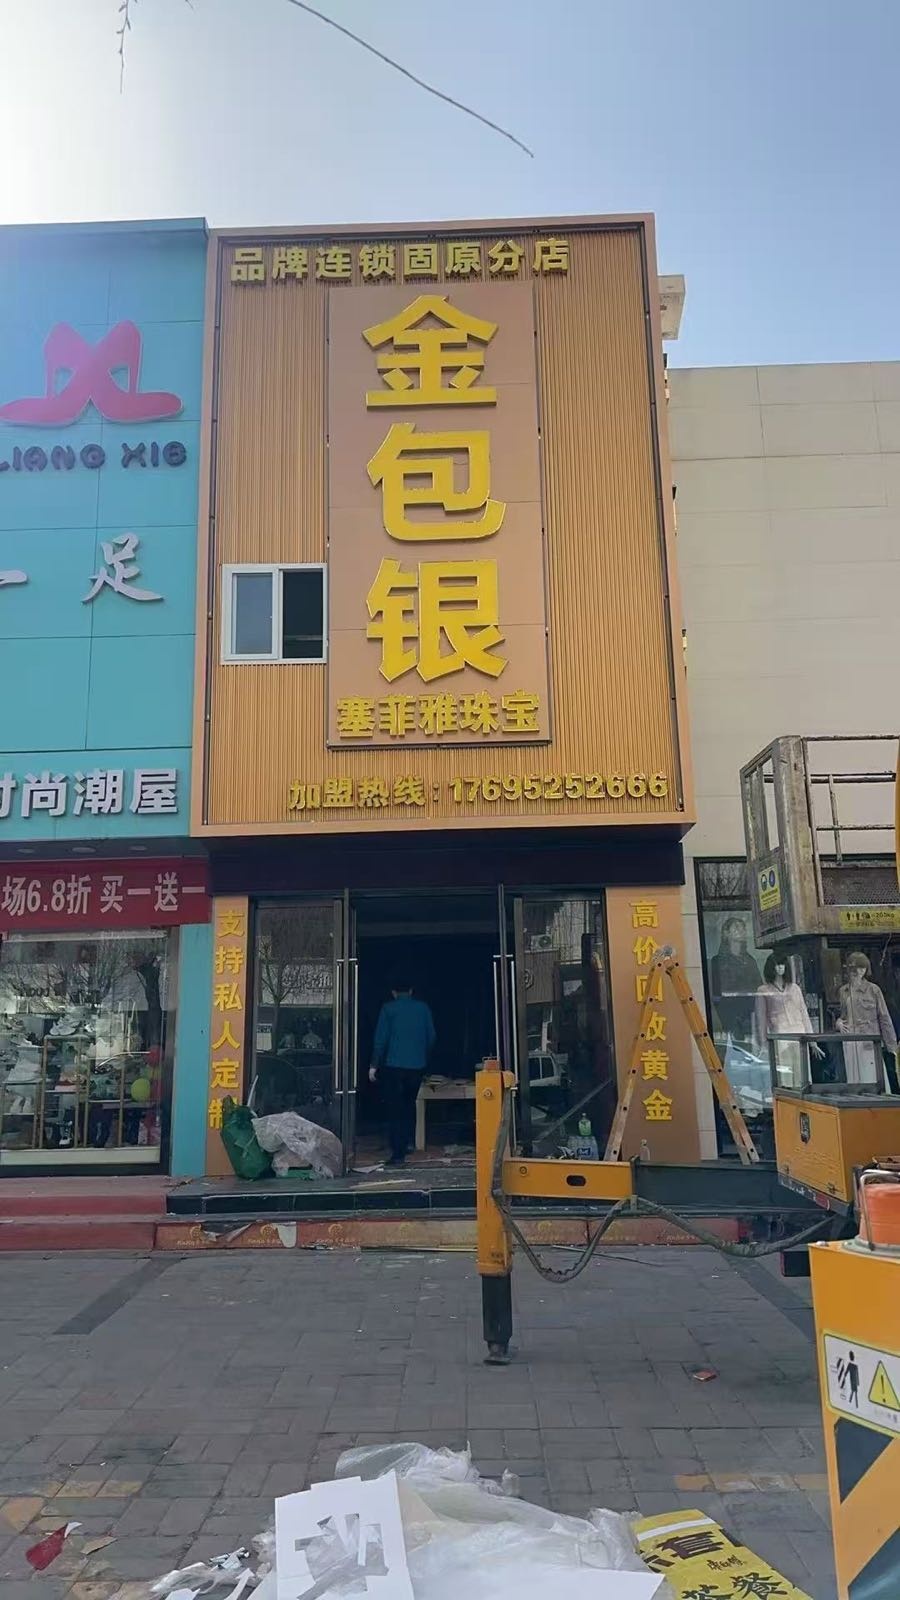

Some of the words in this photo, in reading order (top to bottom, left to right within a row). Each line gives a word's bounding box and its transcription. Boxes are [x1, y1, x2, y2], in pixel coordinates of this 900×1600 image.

[230, 238, 569, 283] 品牌连锁固原分店
[362, 294, 508, 683] 金包银
[337, 688, 540, 738] 塞菲雅珠宝
[100, 872, 205, 913] 买一送一
